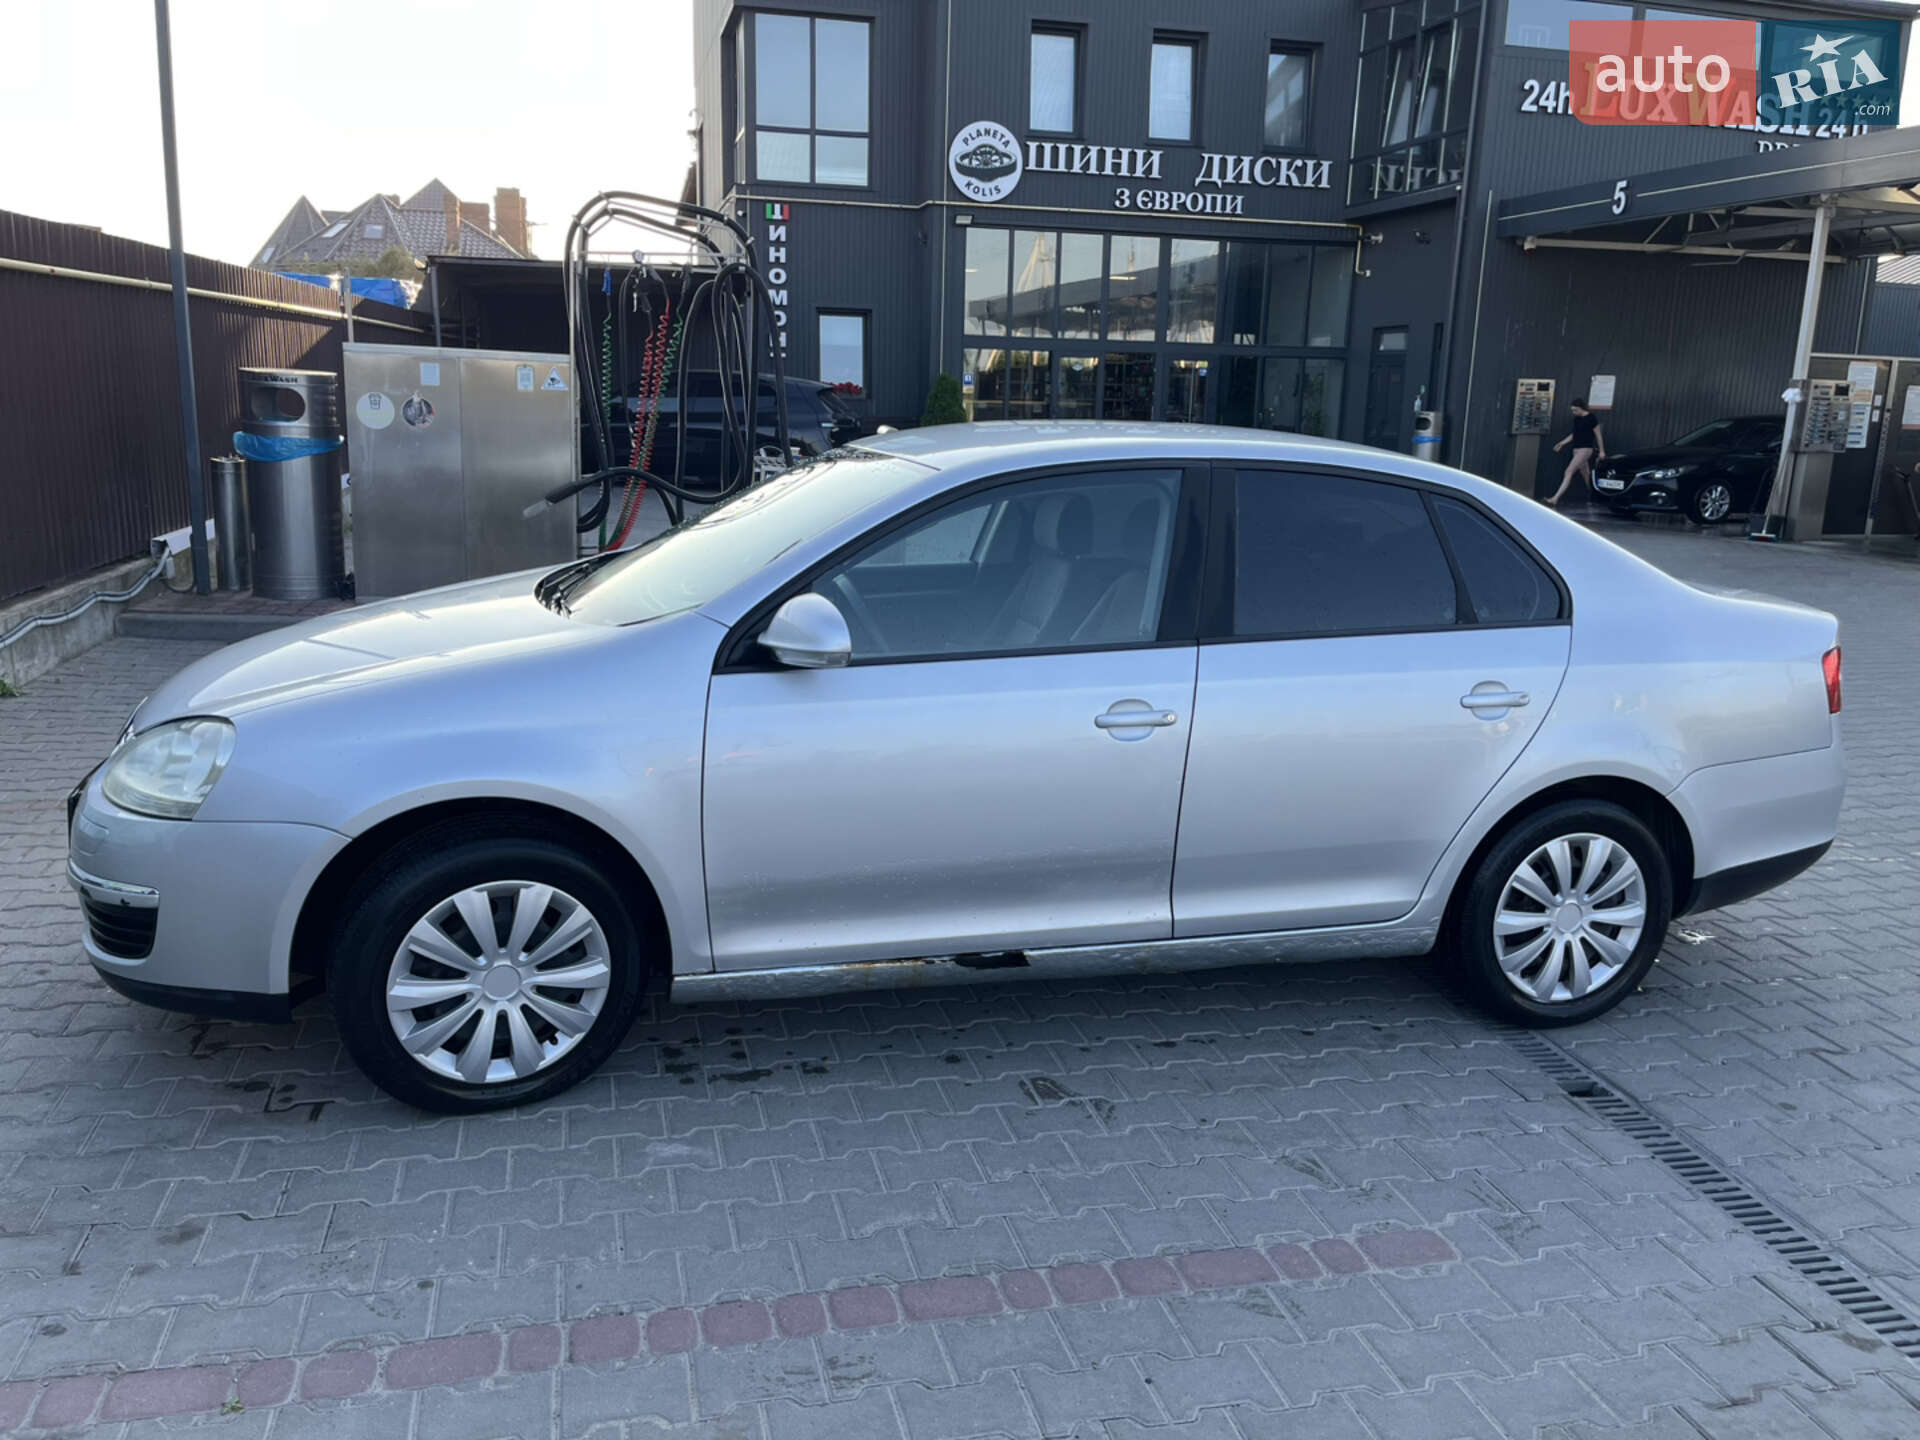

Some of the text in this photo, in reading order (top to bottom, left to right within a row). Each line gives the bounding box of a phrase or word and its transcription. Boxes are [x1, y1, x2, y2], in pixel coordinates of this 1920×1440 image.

[962, 127, 1010, 148] PLANETA
[1025, 141, 1164, 180] ШИНИ
[1195, 152, 1334, 189] ДИСКИ
[964, 180, 1002, 197] KOLIS
[1612, 180, 1627, 214] 5
[1136, 189, 1245, 216] ЄВРОПИ
